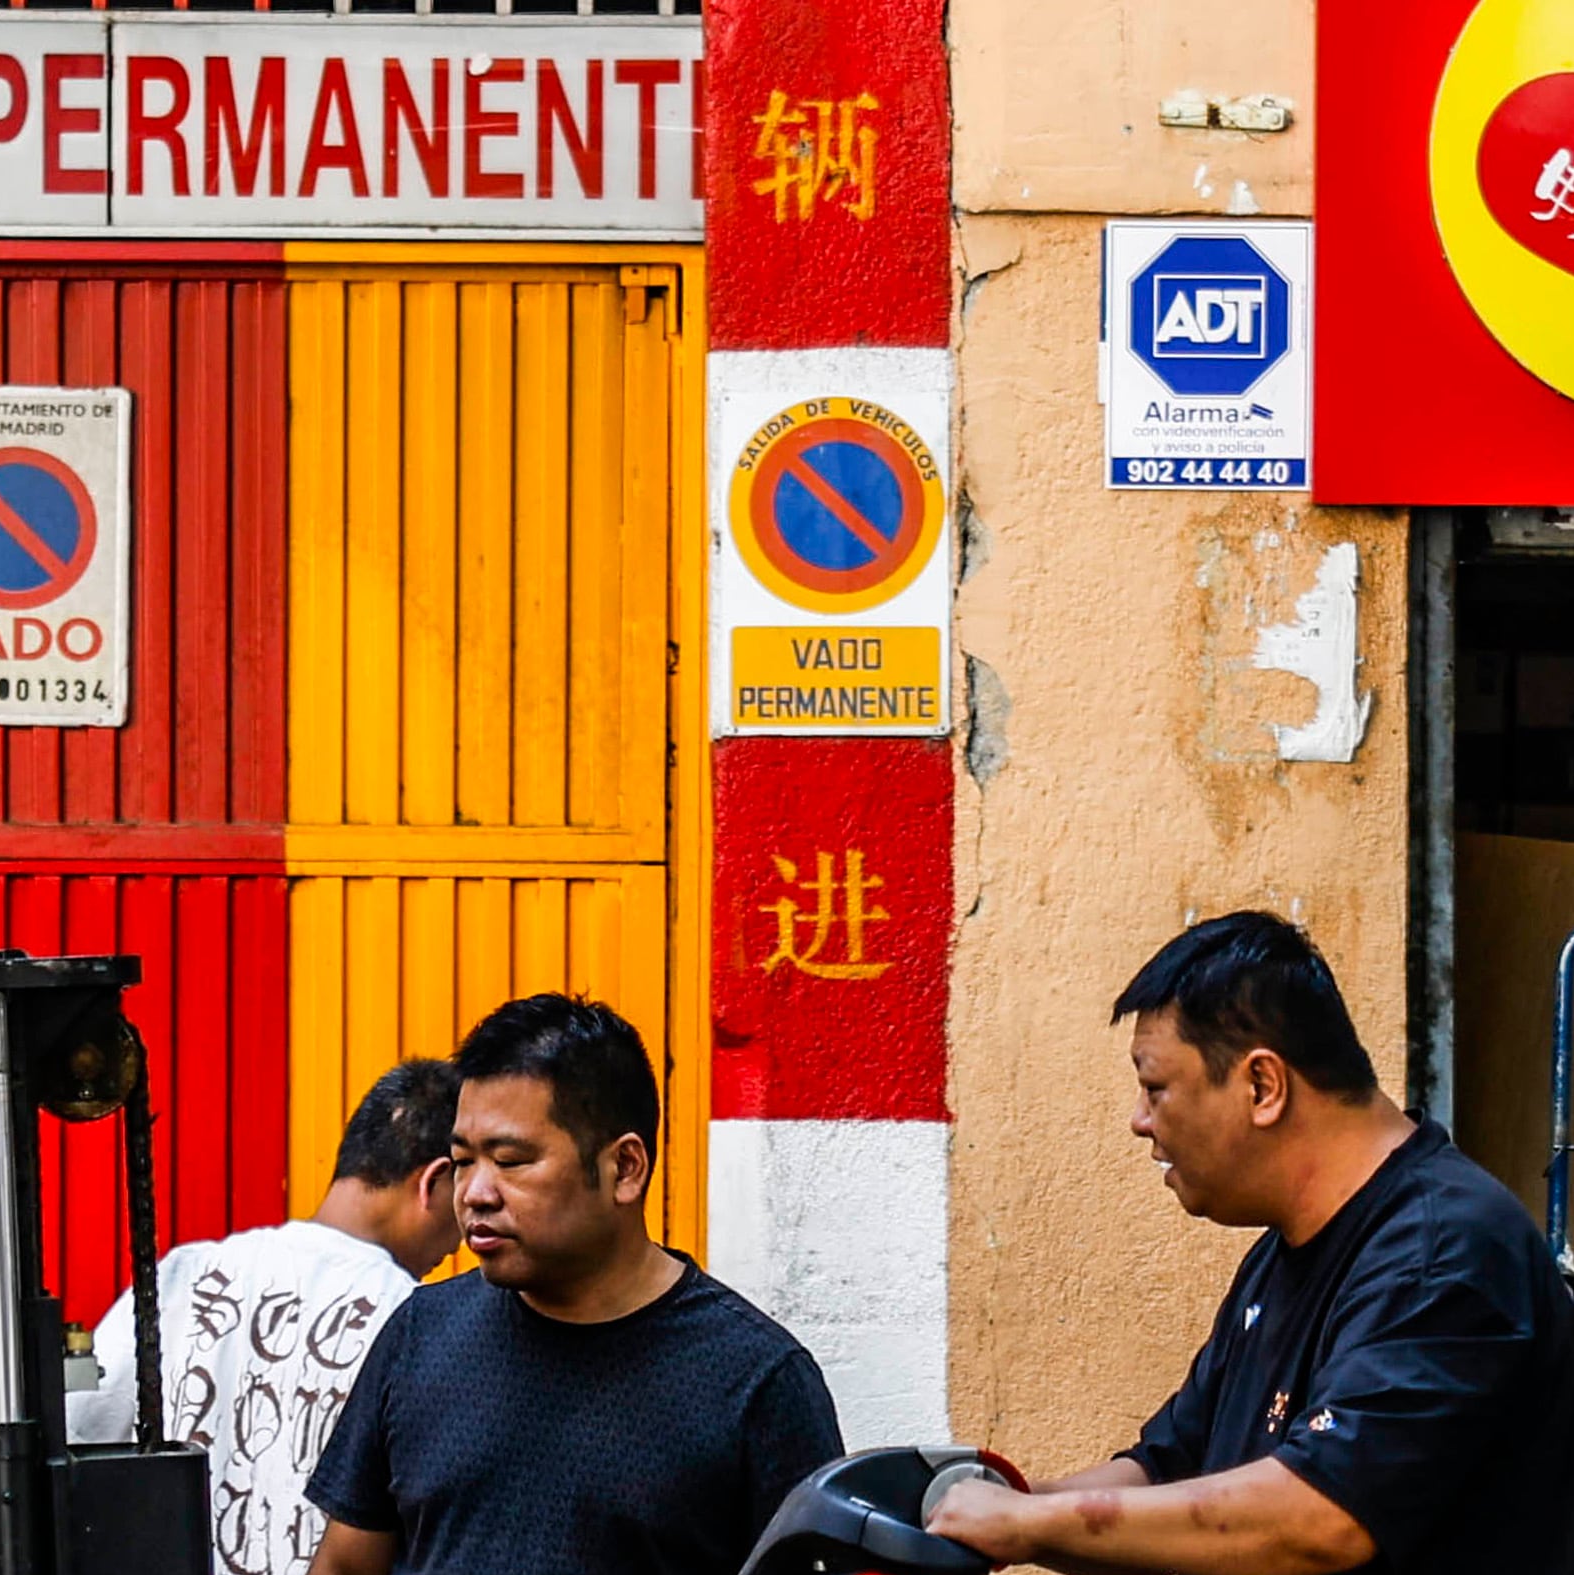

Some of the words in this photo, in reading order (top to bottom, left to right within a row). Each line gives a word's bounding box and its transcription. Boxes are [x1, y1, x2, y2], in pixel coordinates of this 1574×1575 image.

[1156, 288, 1264, 344] ADT
[92, 403, 114, 418] DE
[1143, 402, 1239, 423] Alarma
[0, 421, 65, 437] MADRID
[738, 415, 795, 472] SALIDA
[805, 400, 830, 418] DE
[849, 400, 938, 482] VEHICULOS
[1166, 441, 1202, 453] aviso
[1127, 459, 1175, 482] 902
[1180, 460, 1213, 483] 44
[1219, 460, 1251, 483] 44
[1256, 461, 1289, 484] 40
[791, 638, 883, 670] VADO
[738, 686, 935, 718] PERMANENTE
[758, 848, 895, 980] 进
